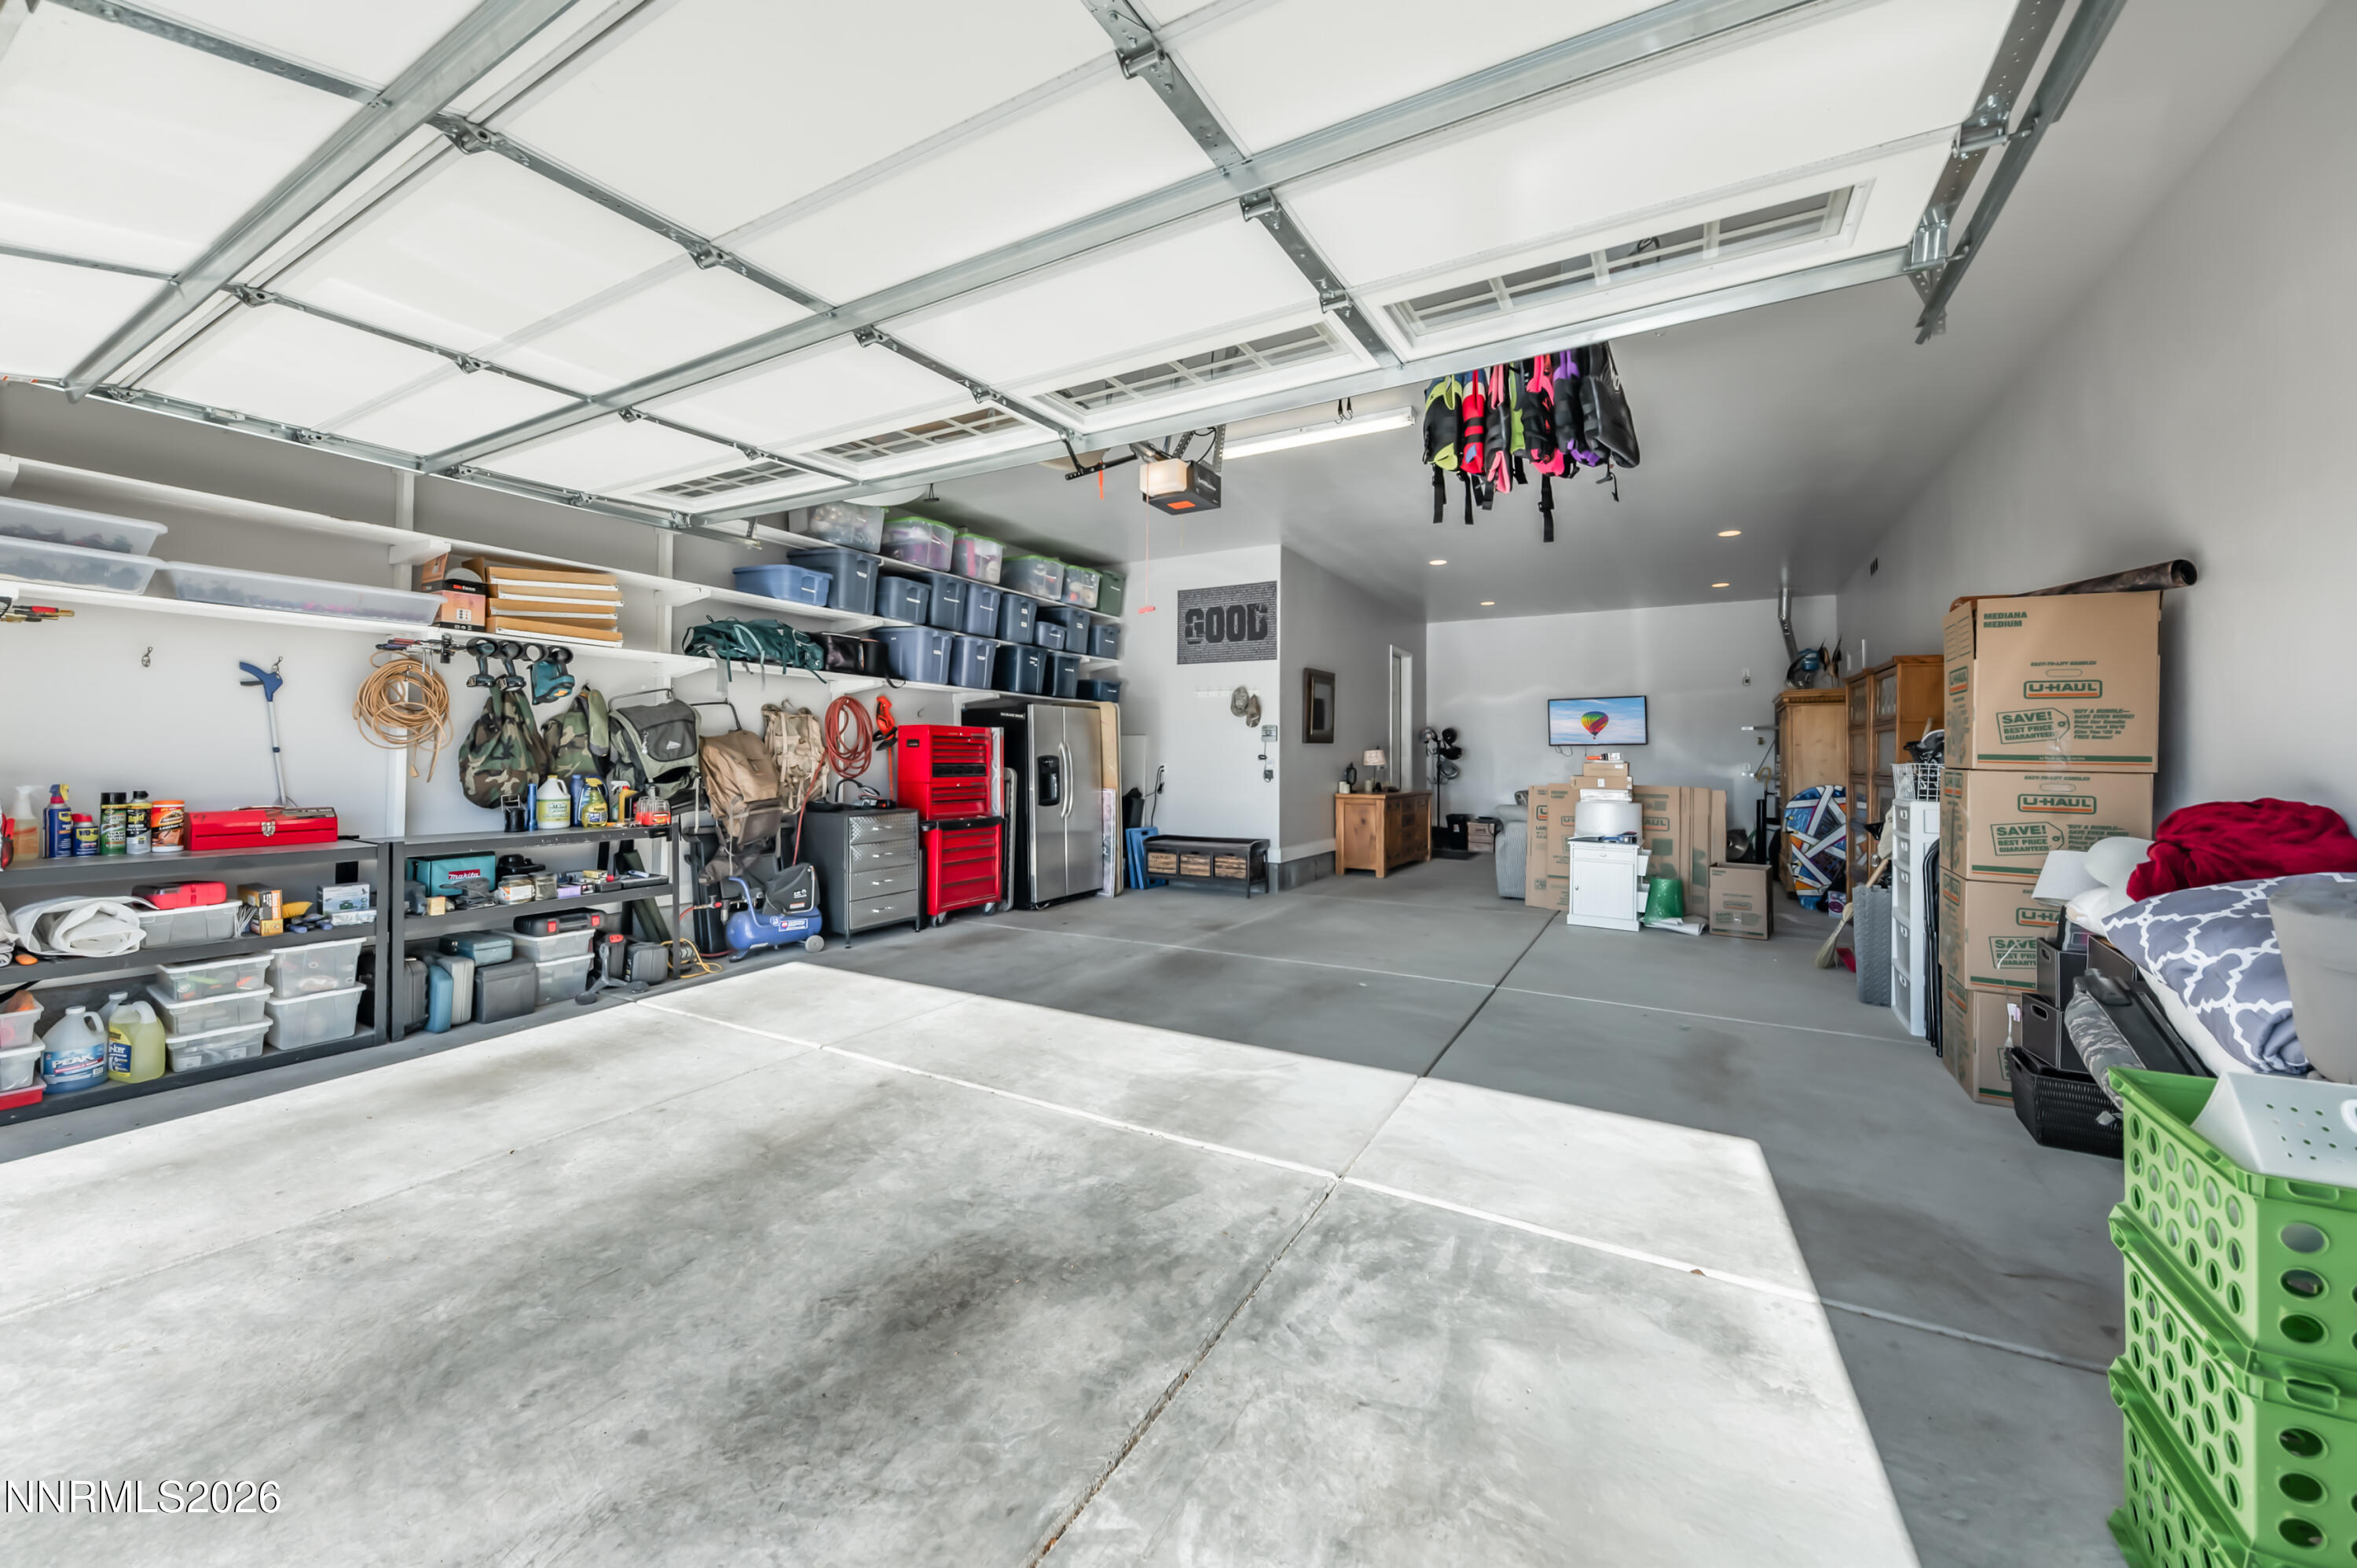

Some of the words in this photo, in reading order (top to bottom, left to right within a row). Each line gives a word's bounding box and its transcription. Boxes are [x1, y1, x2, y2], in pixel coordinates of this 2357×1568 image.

[1984, 611, 2028, 620] MEDIANA
[1185, 603, 1268, 644] GOOD
[1983, 620, 2023, 628] MEDIUM
[2029, 683, 2097, 692] U-HAUL
[2002, 711, 2053, 724] SAVE!
[2022, 797, 2091, 807] U-HAUL
[1996, 825, 2047, 836] SAVE!
[2022, 911, 2060, 921] U-H
[1995, 939, 2036, 949] SAVE
[52, 1053, 94, 1068] PEAK
